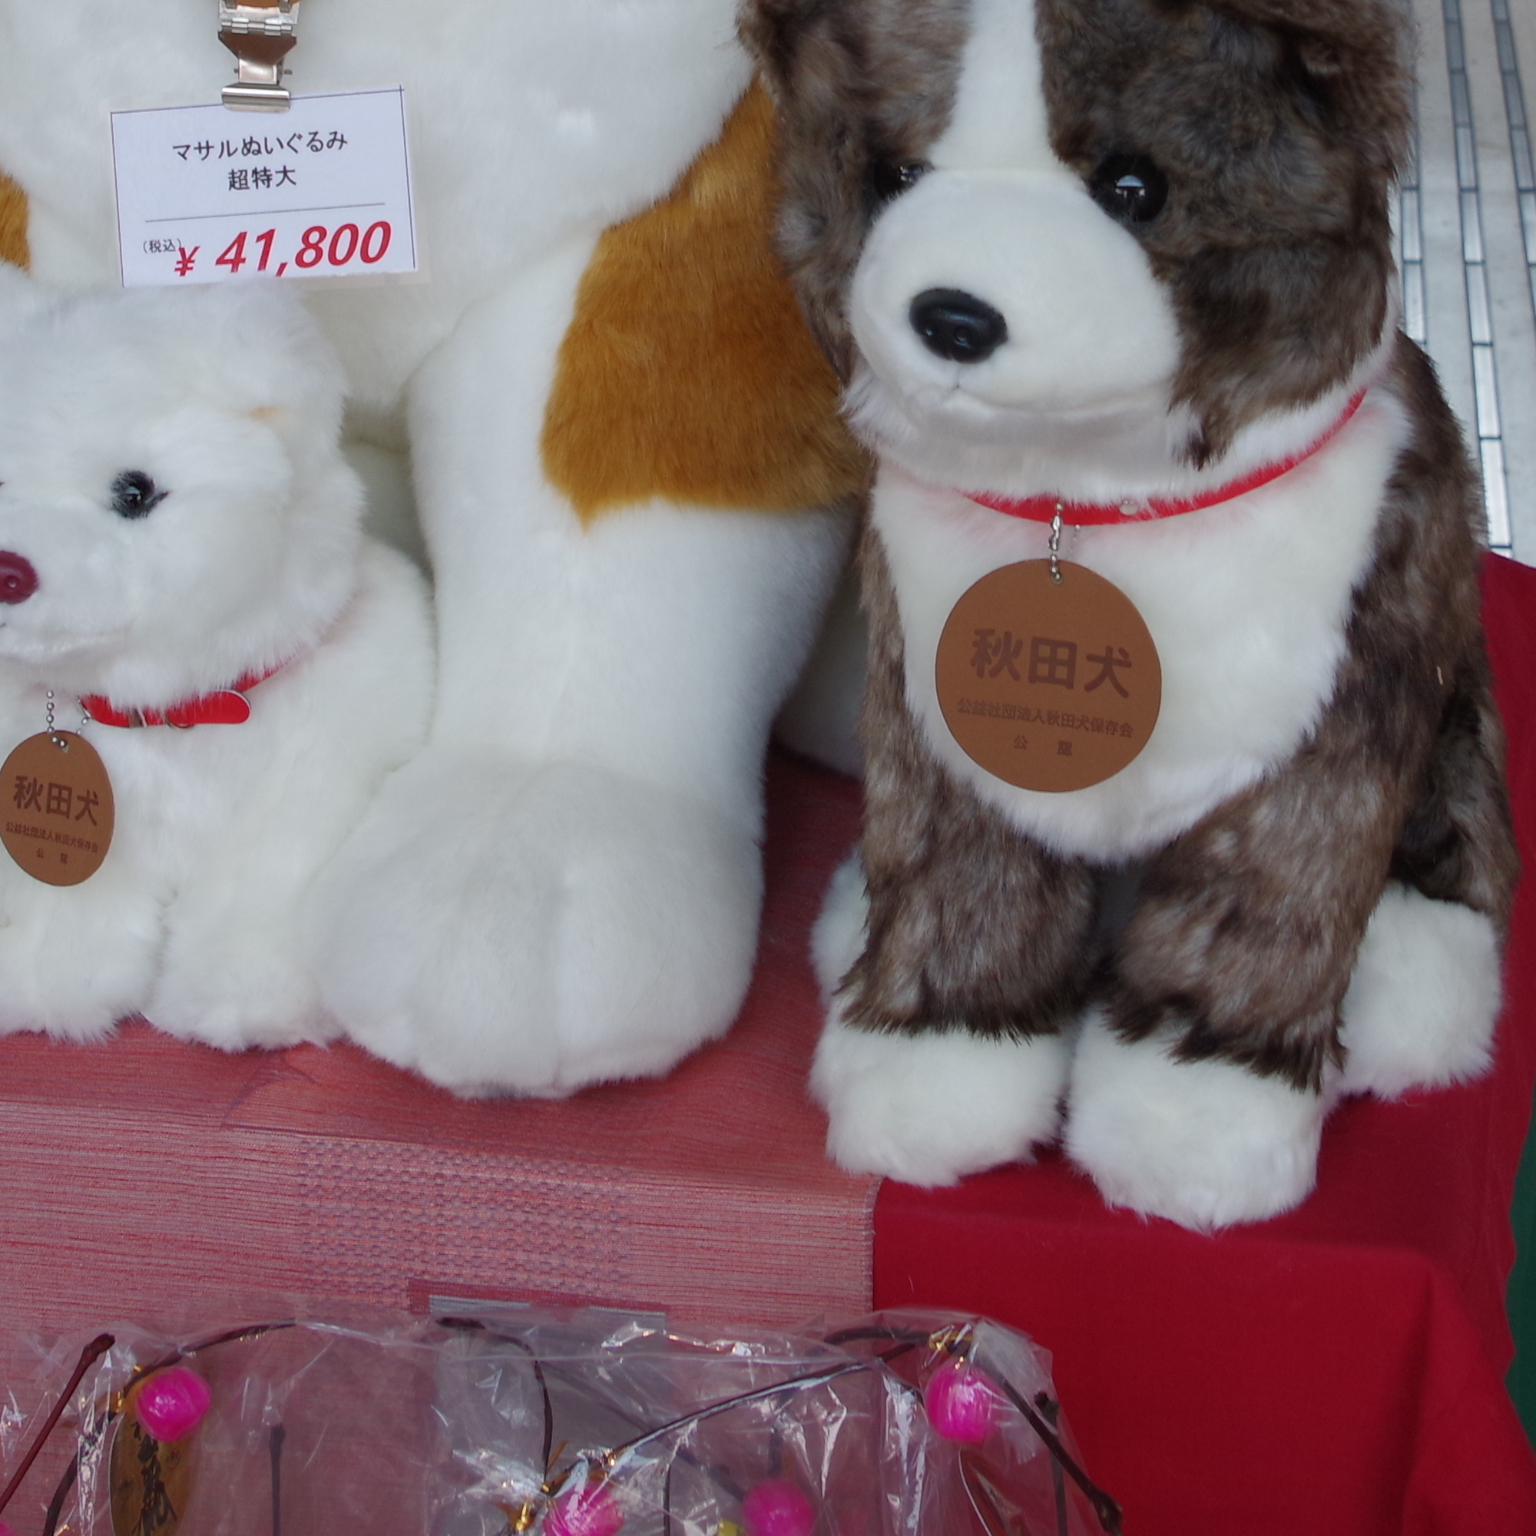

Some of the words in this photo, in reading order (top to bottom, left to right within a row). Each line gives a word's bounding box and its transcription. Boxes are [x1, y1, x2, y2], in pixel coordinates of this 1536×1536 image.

[171, 130, 349, 162] マサルぬいぐるみ
[227, 165, 299, 192] 超特大
[214, 219, 393, 279] 41,800
[969, 627, 1133, 699] 秋田犬
[956, 697, 1134, 739] 公益社団法人秋田犬保存会
[13, 775, 100, 827] 秋田犬
